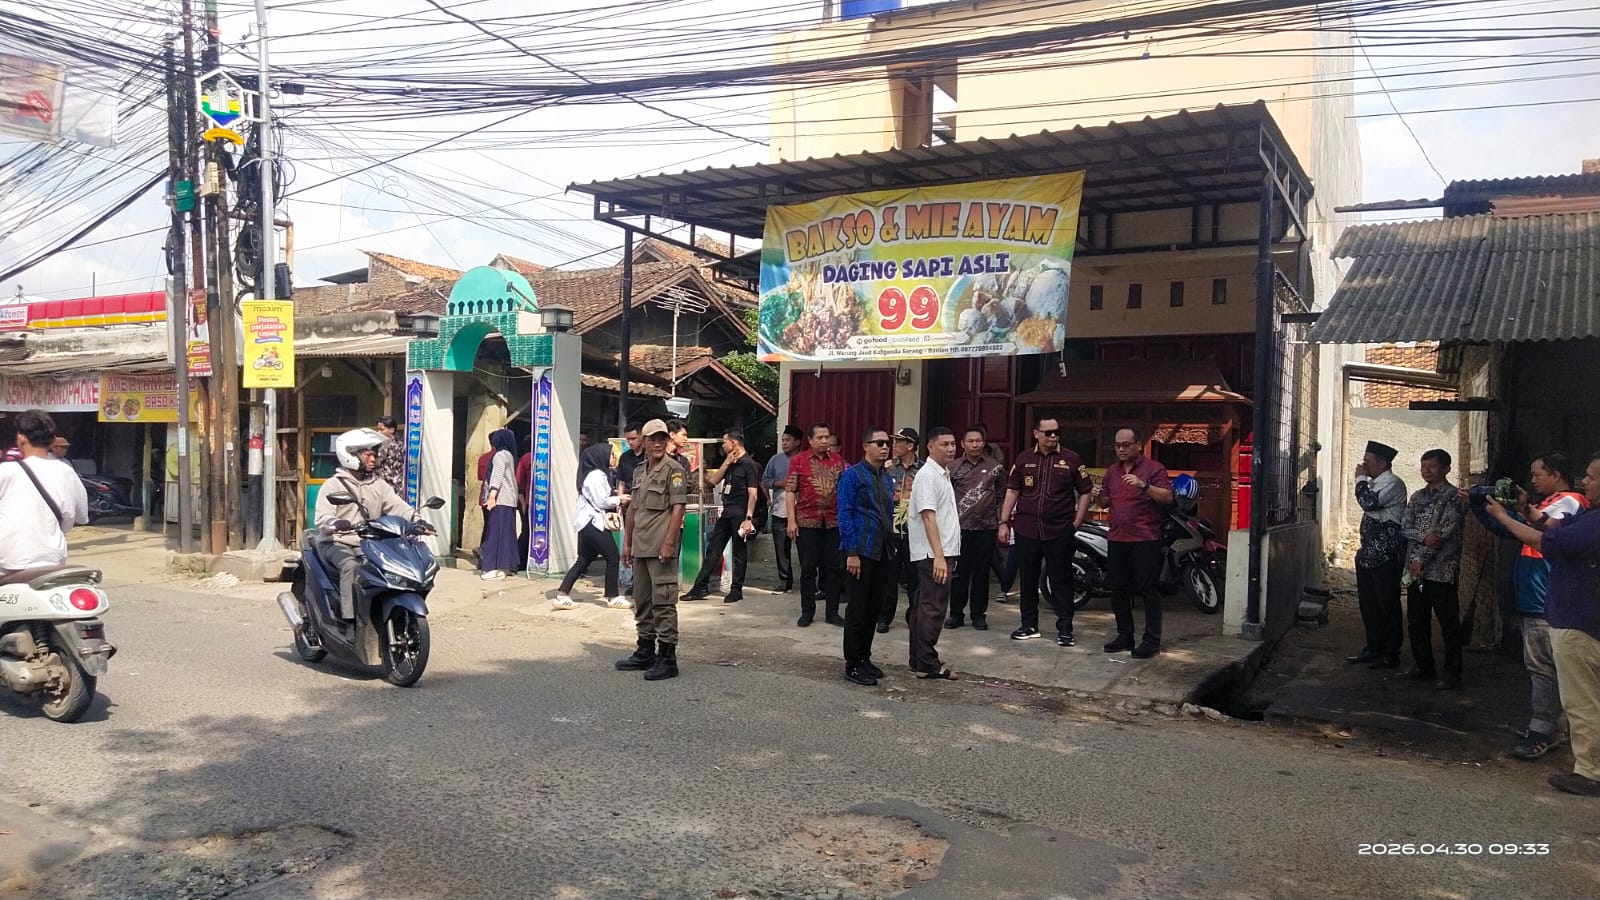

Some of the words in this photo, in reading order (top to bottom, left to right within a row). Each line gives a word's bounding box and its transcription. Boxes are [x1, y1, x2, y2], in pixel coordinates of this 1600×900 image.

[786, 209, 875, 262] BAKSO
[880, 206, 900, 243] &
[905, 202, 962, 240] MIE
[962, 202, 1059, 245] AYAM
[823, 260, 898, 284] DAGING
[902, 256, 954, 279] SAPI
[958, 252, 1010, 276] ASLI
[878, 286, 940, 331] 99
[45, 376, 99, 405] HANDPHONE
